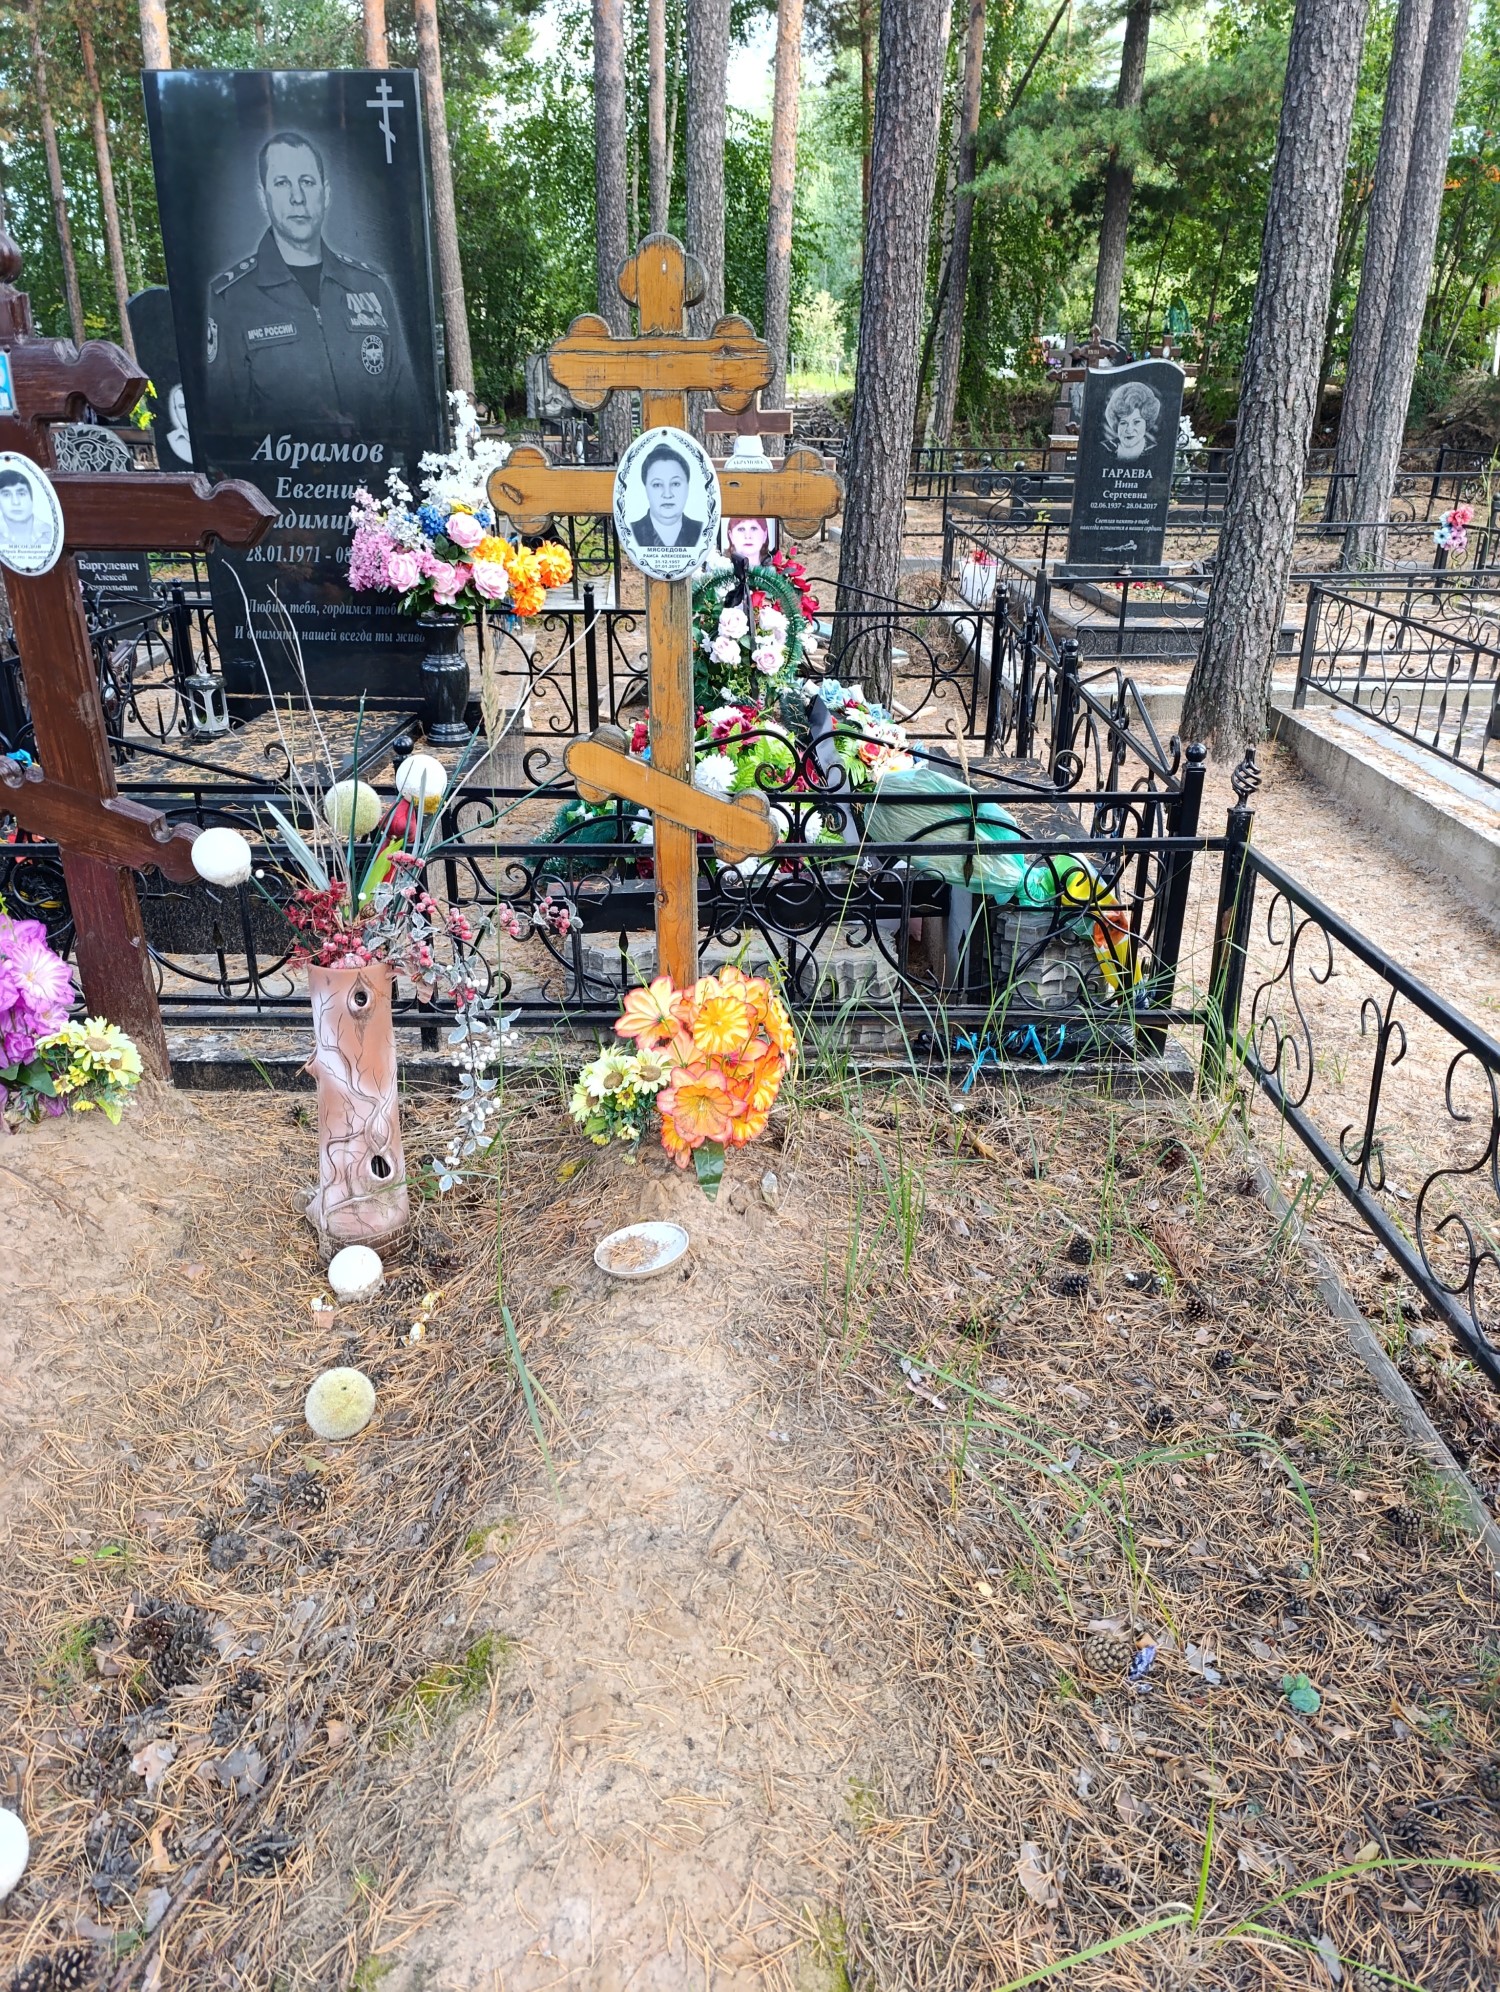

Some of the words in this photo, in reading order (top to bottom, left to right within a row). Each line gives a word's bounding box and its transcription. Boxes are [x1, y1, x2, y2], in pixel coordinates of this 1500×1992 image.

[264, 323, 294, 337] РОССИИ
[252, 433, 384, 470] Абрамов
[1102, 467, 1153, 479] ГАРАЕВА
[275, 476, 369, 499] Евгений
[1114, 480, 1139, 489] Нина
[1102, 490, 1148, 500] Сергеевна
[246, 544, 321, 563] 28.01.1971
[77, 559, 140, 573] Баргулевич
[94, 573, 128, 582] Алексей
[290, 600, 320, 617] тебя,
[322, 601, 372, 619] гордимся
[234, 625, 244, 639] И
[301, 628, 337, 641] нашей
[339, 628, 372, 642] всегда
[375, 631, 393, 643] ты
[395, 632, 426, 643] живо
